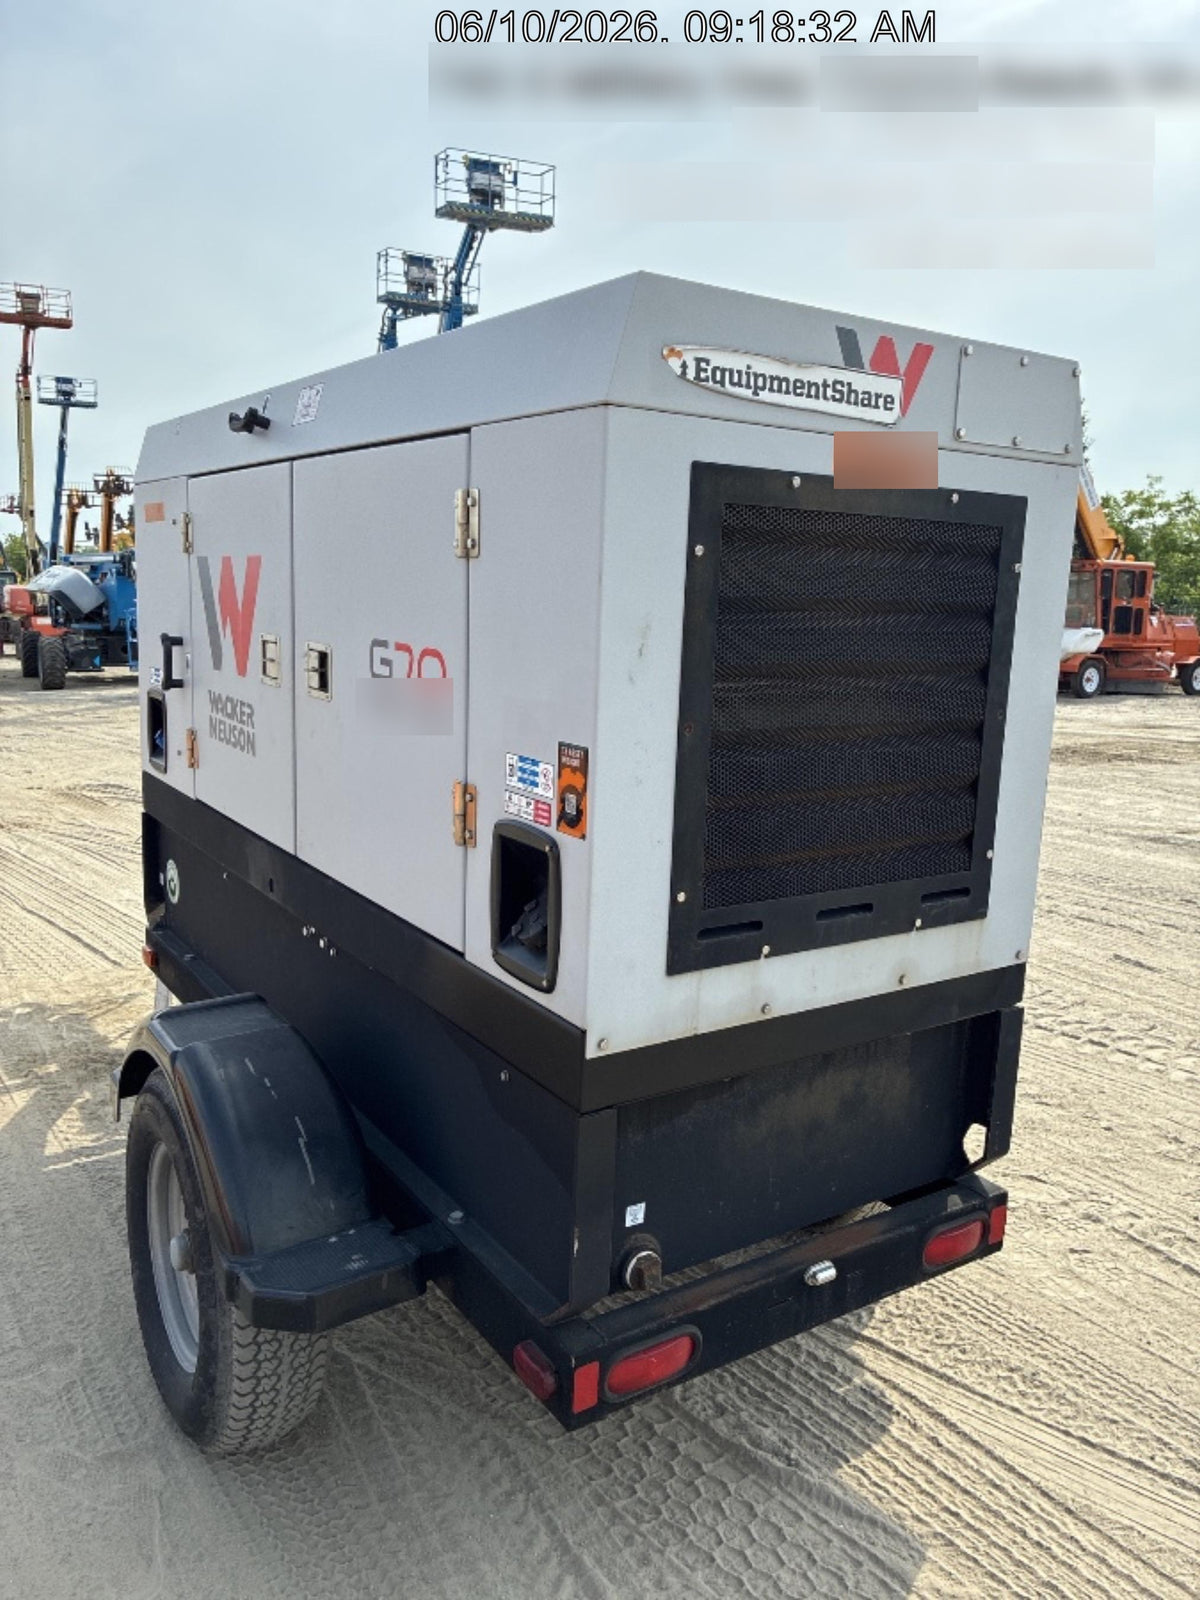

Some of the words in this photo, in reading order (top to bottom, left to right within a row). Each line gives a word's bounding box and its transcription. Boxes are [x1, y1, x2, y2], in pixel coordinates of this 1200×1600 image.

[693, 356, 896, 412] EquipmentShare
[208, 689, 255, 729] WACKER
[208, 714, 256, 757] NEUSON
